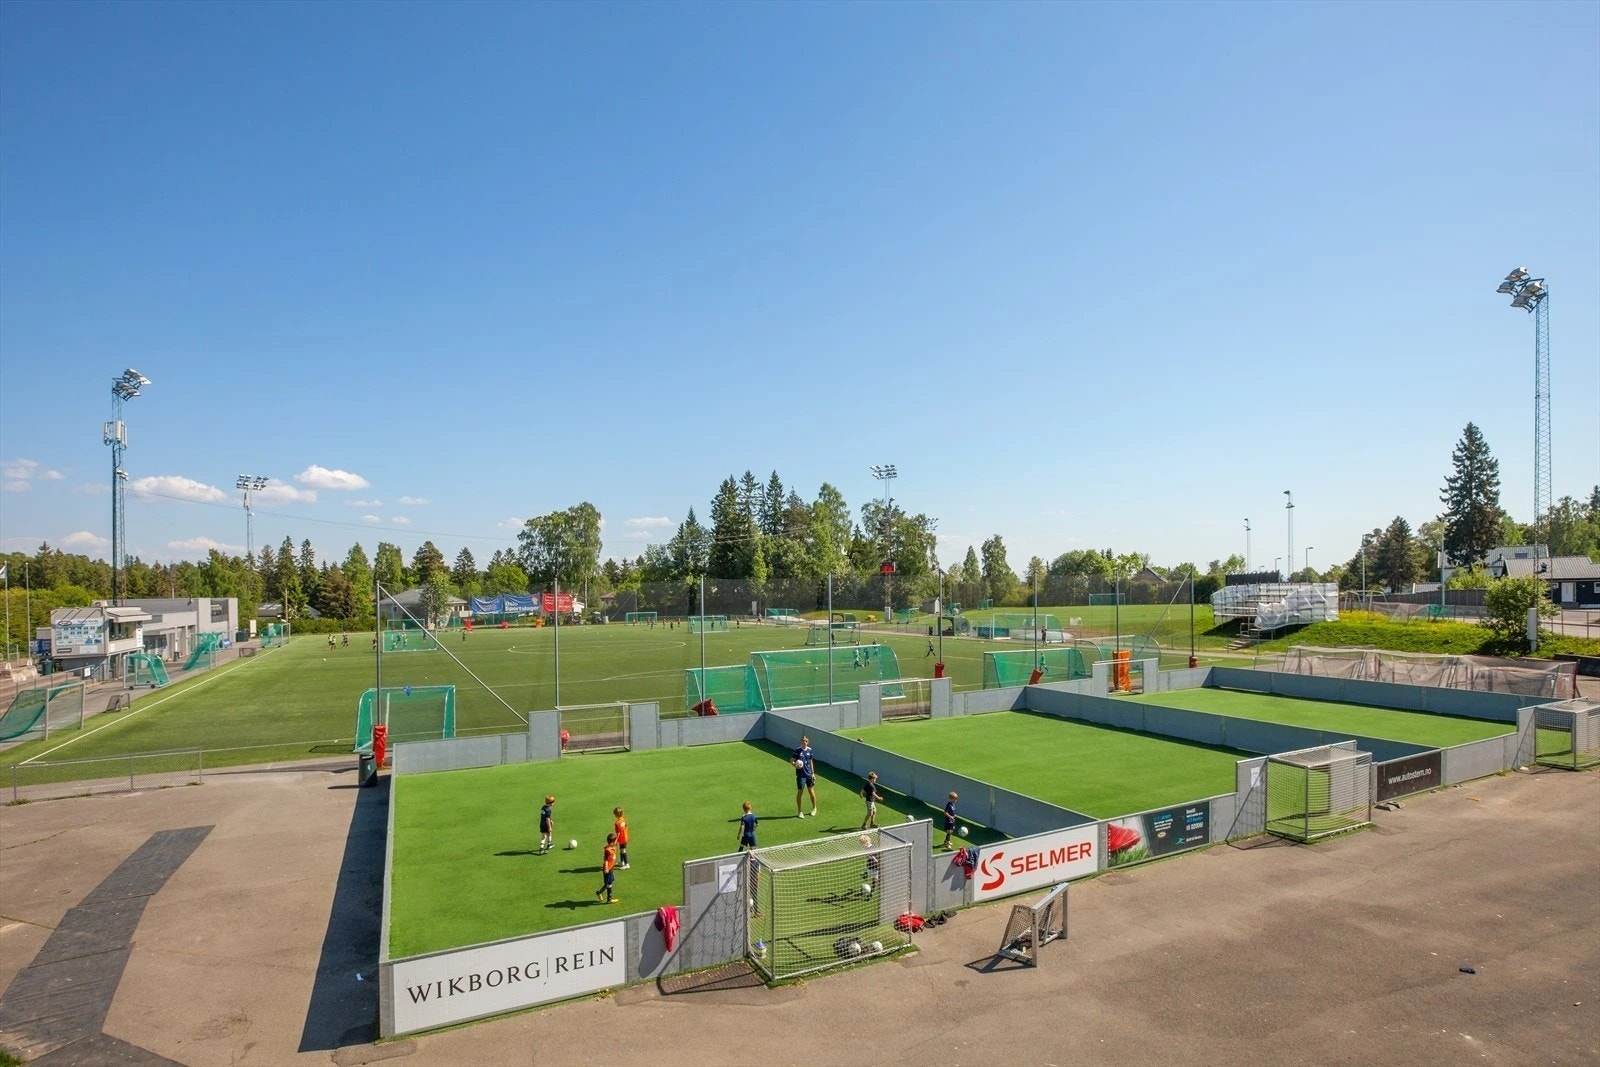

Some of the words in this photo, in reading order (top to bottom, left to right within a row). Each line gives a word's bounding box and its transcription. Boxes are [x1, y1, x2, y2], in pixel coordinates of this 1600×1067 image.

[1010, 842, 1092, 876] SELMER
[407, 961, 541, 1004] WIKBORG
[555, 946, 615, 974] REIN
